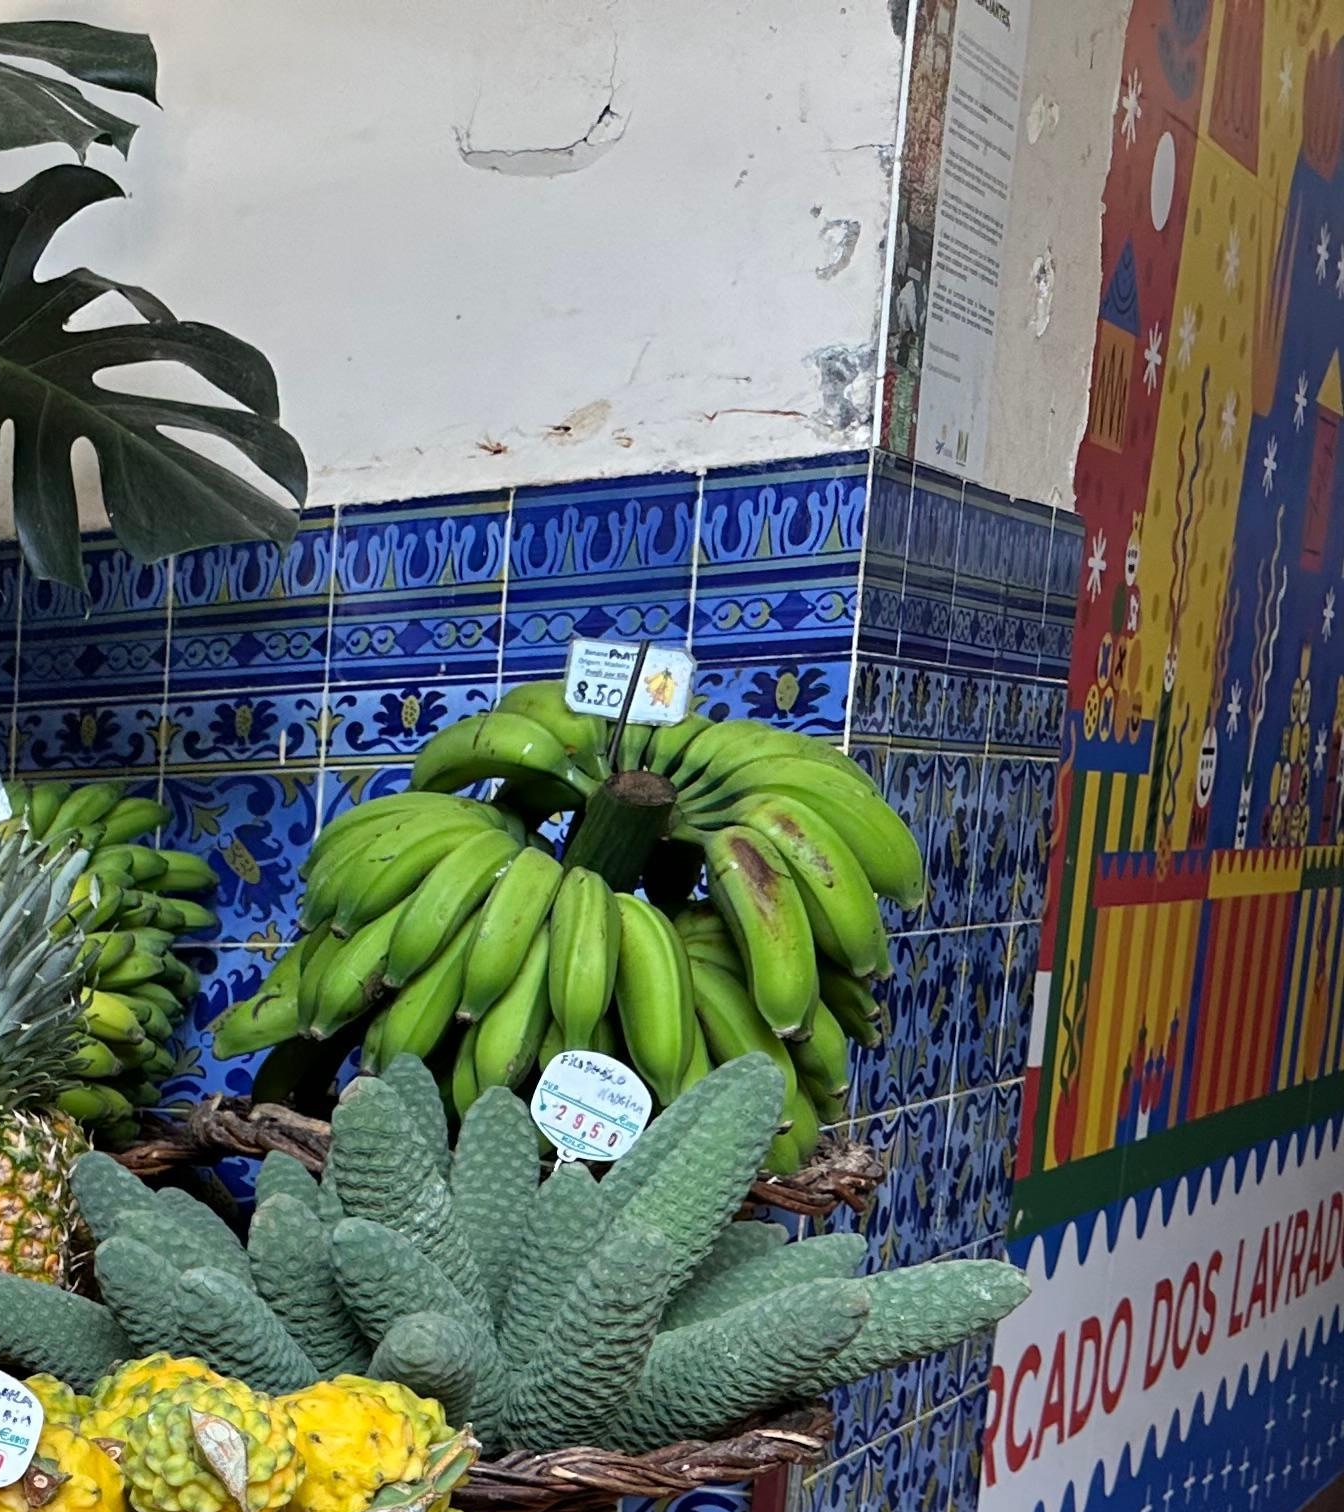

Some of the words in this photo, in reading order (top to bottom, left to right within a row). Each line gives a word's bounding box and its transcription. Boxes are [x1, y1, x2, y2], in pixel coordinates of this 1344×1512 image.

[555, 1104, 619, 1148] 29,50
[1143, 1250, 1223, 1391] DOS
[1227, 1191, 1344, 1338] LAVRAD
